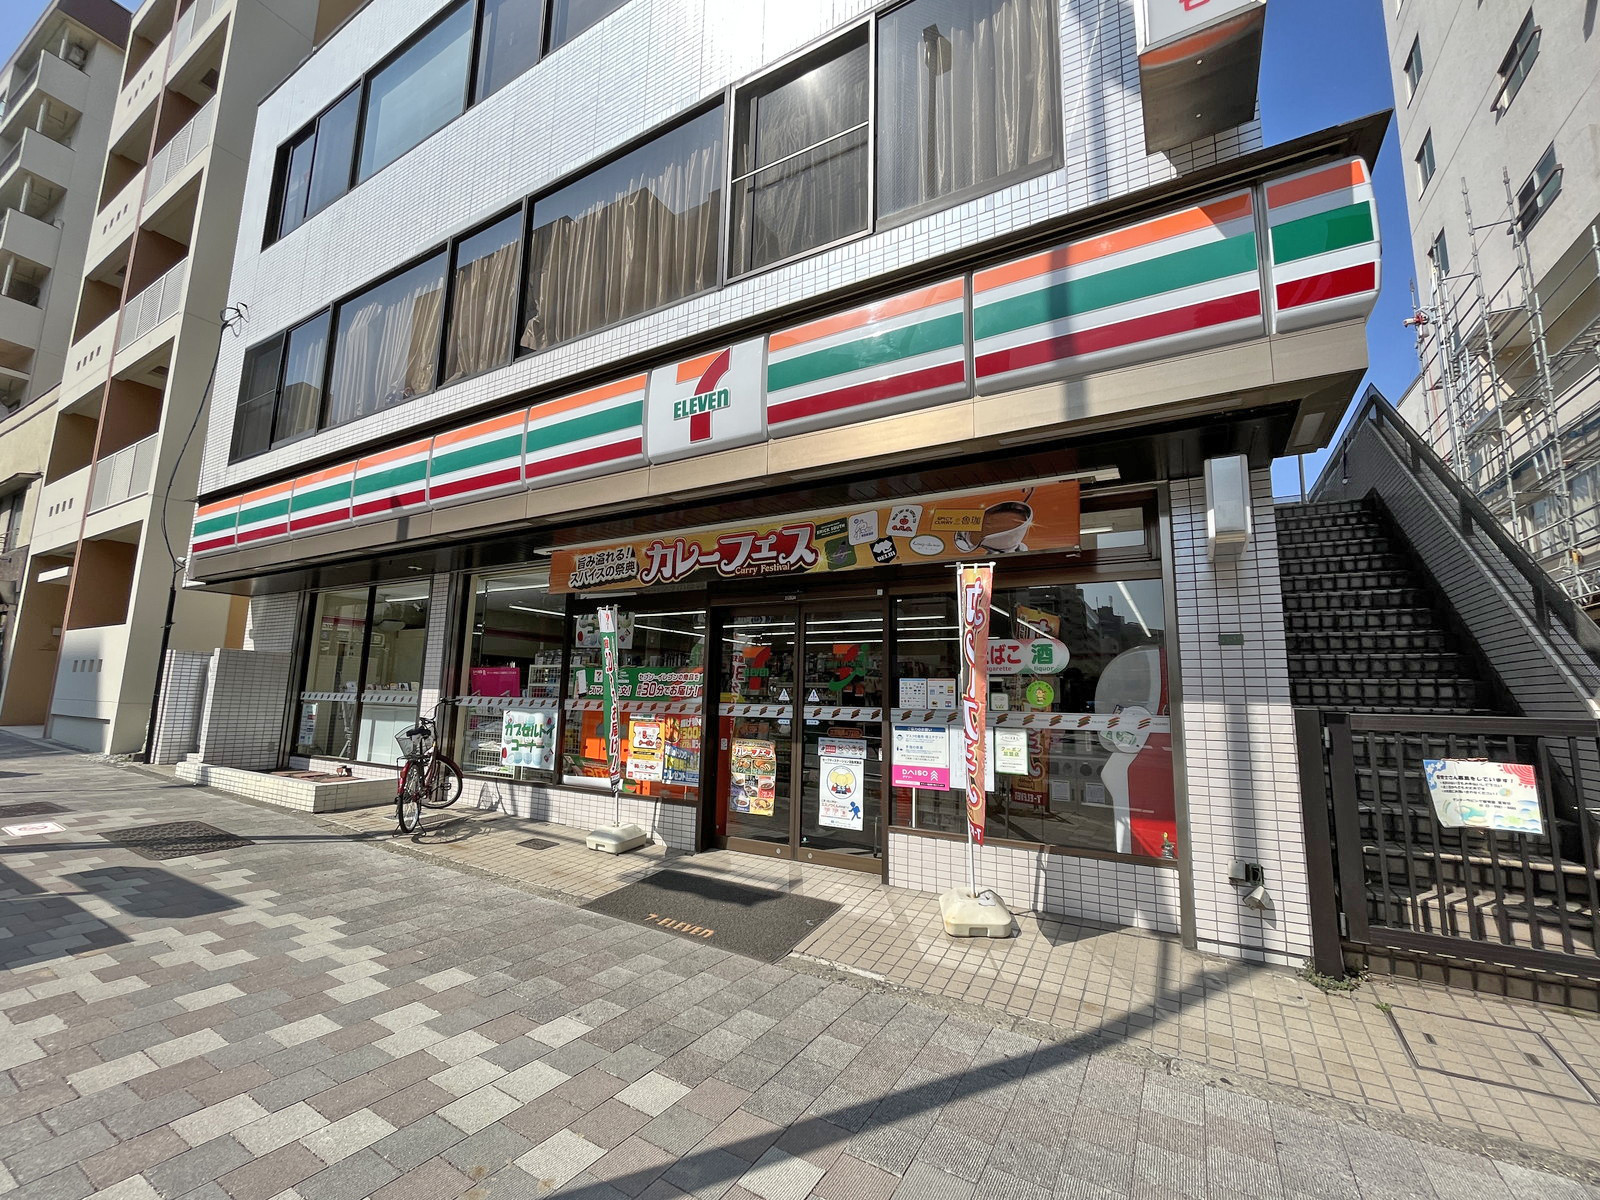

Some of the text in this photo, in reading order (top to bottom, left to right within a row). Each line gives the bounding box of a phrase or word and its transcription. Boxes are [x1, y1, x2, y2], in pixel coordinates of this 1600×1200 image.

[577, 547, 632, 570] 旨み溢れる!
[640, 524, 818, 583] カレーフェス
[876, 550, 896, 562] DELHI
[570, 561, 636, 585] スパイスの祭典
[760, 562, 790, 574] Festival
[986, 643, 1022, 665] ばこ
[1031, 643, 1054, 665] 酒
[504, 723, 556, 739] カプセルトイ
[511, 739, 545, 753] コーナー
[902, 768, 929, 777] DAISO
